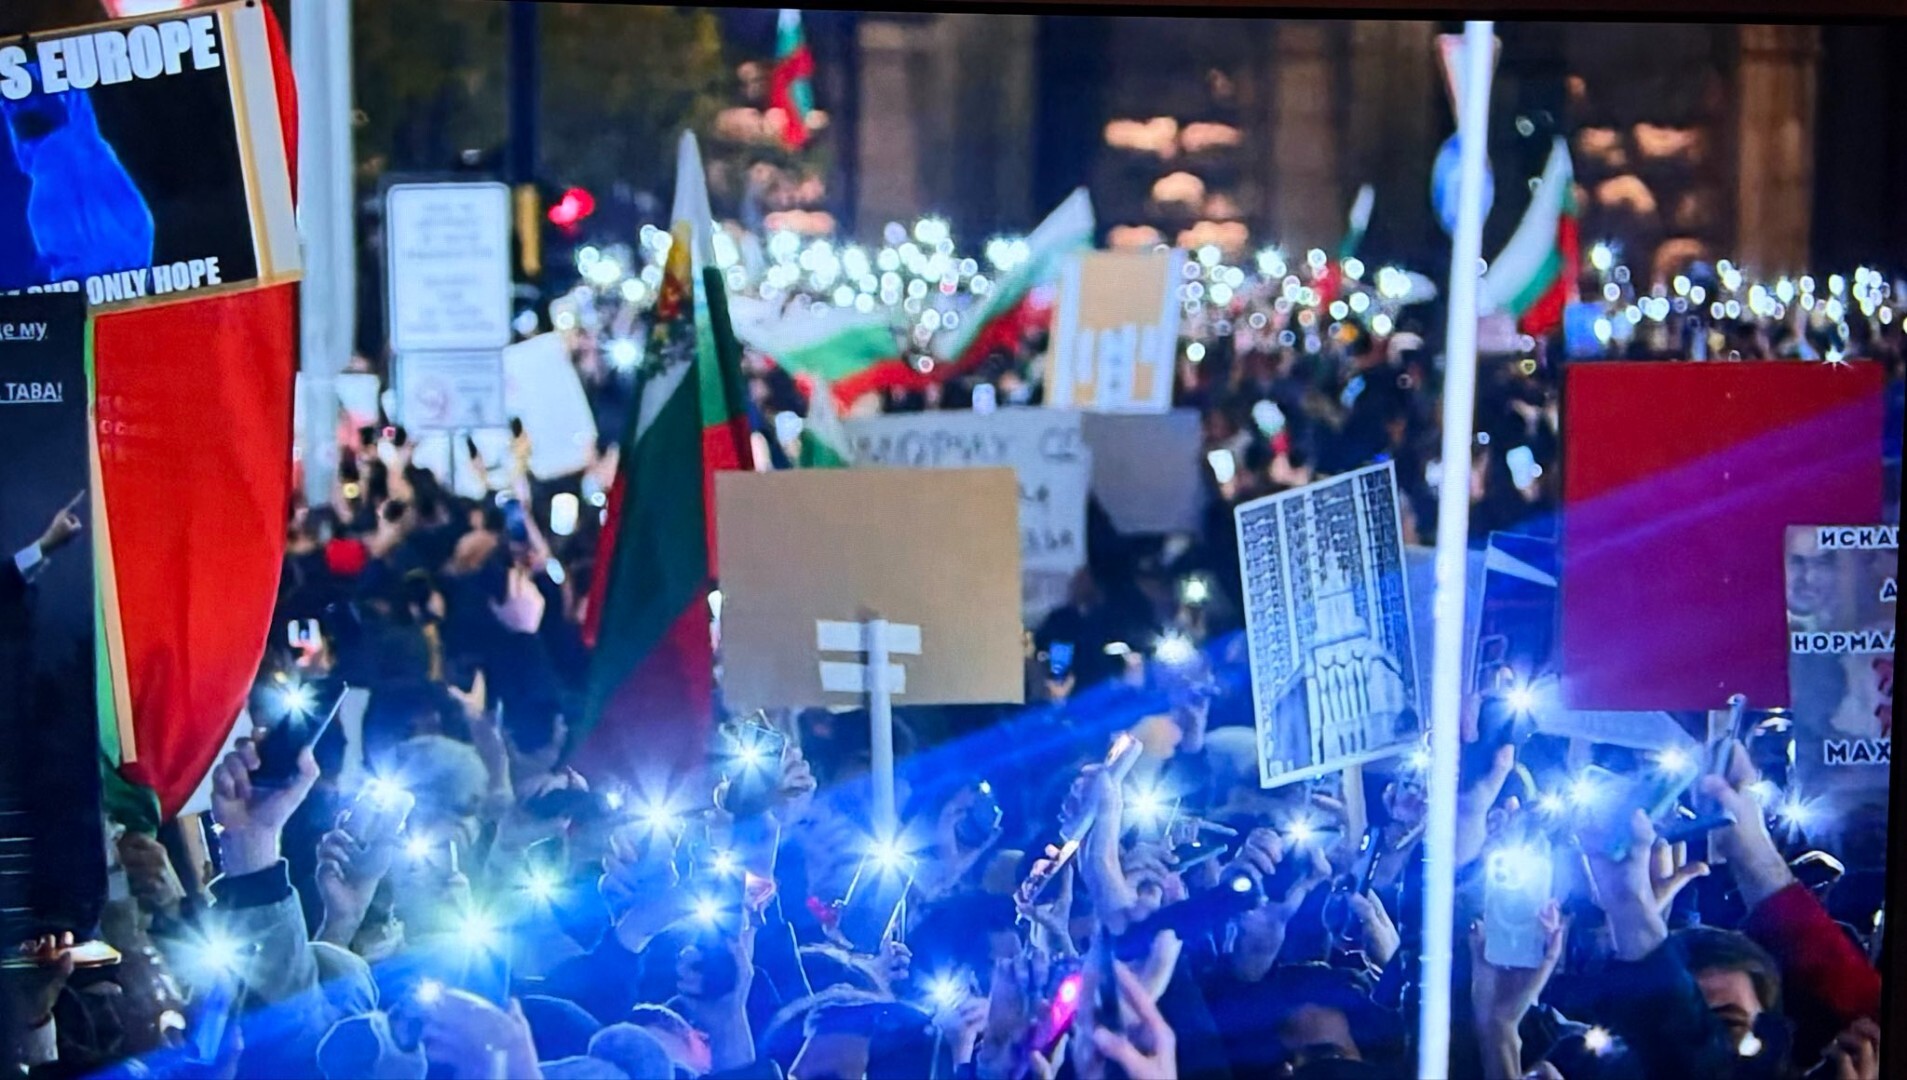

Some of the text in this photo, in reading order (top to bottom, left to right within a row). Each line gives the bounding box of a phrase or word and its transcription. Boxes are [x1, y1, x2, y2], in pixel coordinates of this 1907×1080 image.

[36, 15, 221, 95] EUROPE
[85, 256, 222, 305] ONLY HOPE
[5, 382, 63, 401] ТАВА!
